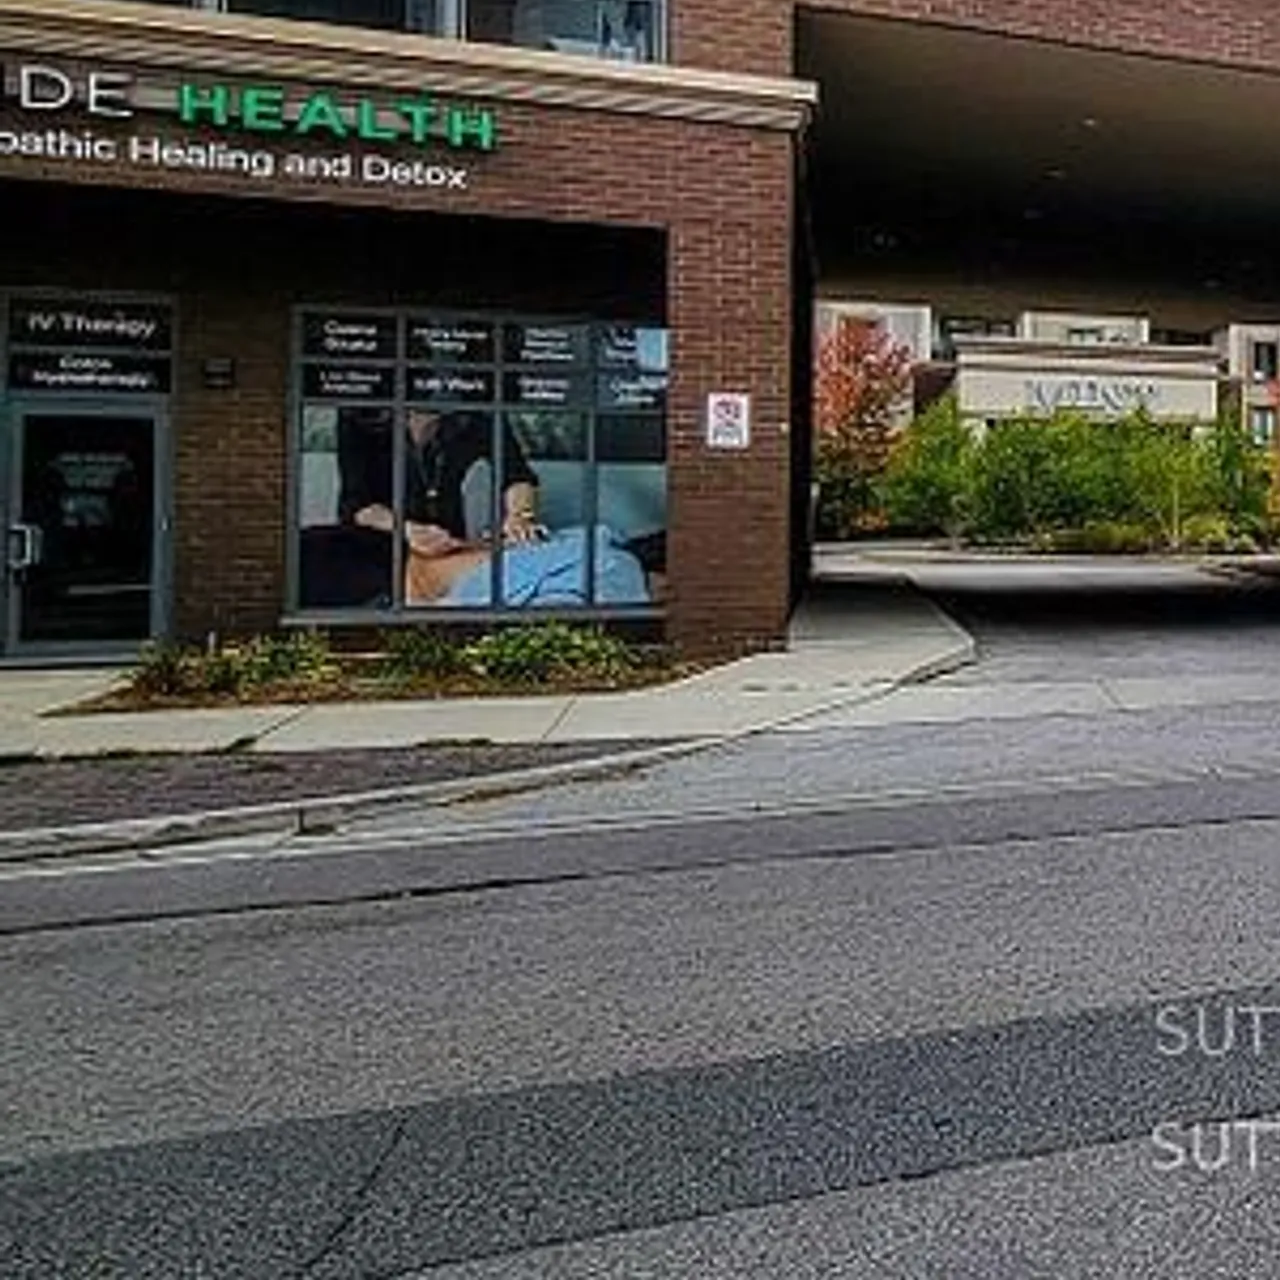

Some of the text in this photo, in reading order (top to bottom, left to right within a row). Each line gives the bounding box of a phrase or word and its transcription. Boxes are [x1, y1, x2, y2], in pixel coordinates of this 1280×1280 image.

[177, 81, 501, 150] HEALTH
[130, 135, 277, 177] Healing
[284, 152, 352, 178] and
[362, 154, 468, 190] Detox
[59, 311, 156, 341] Therapy
